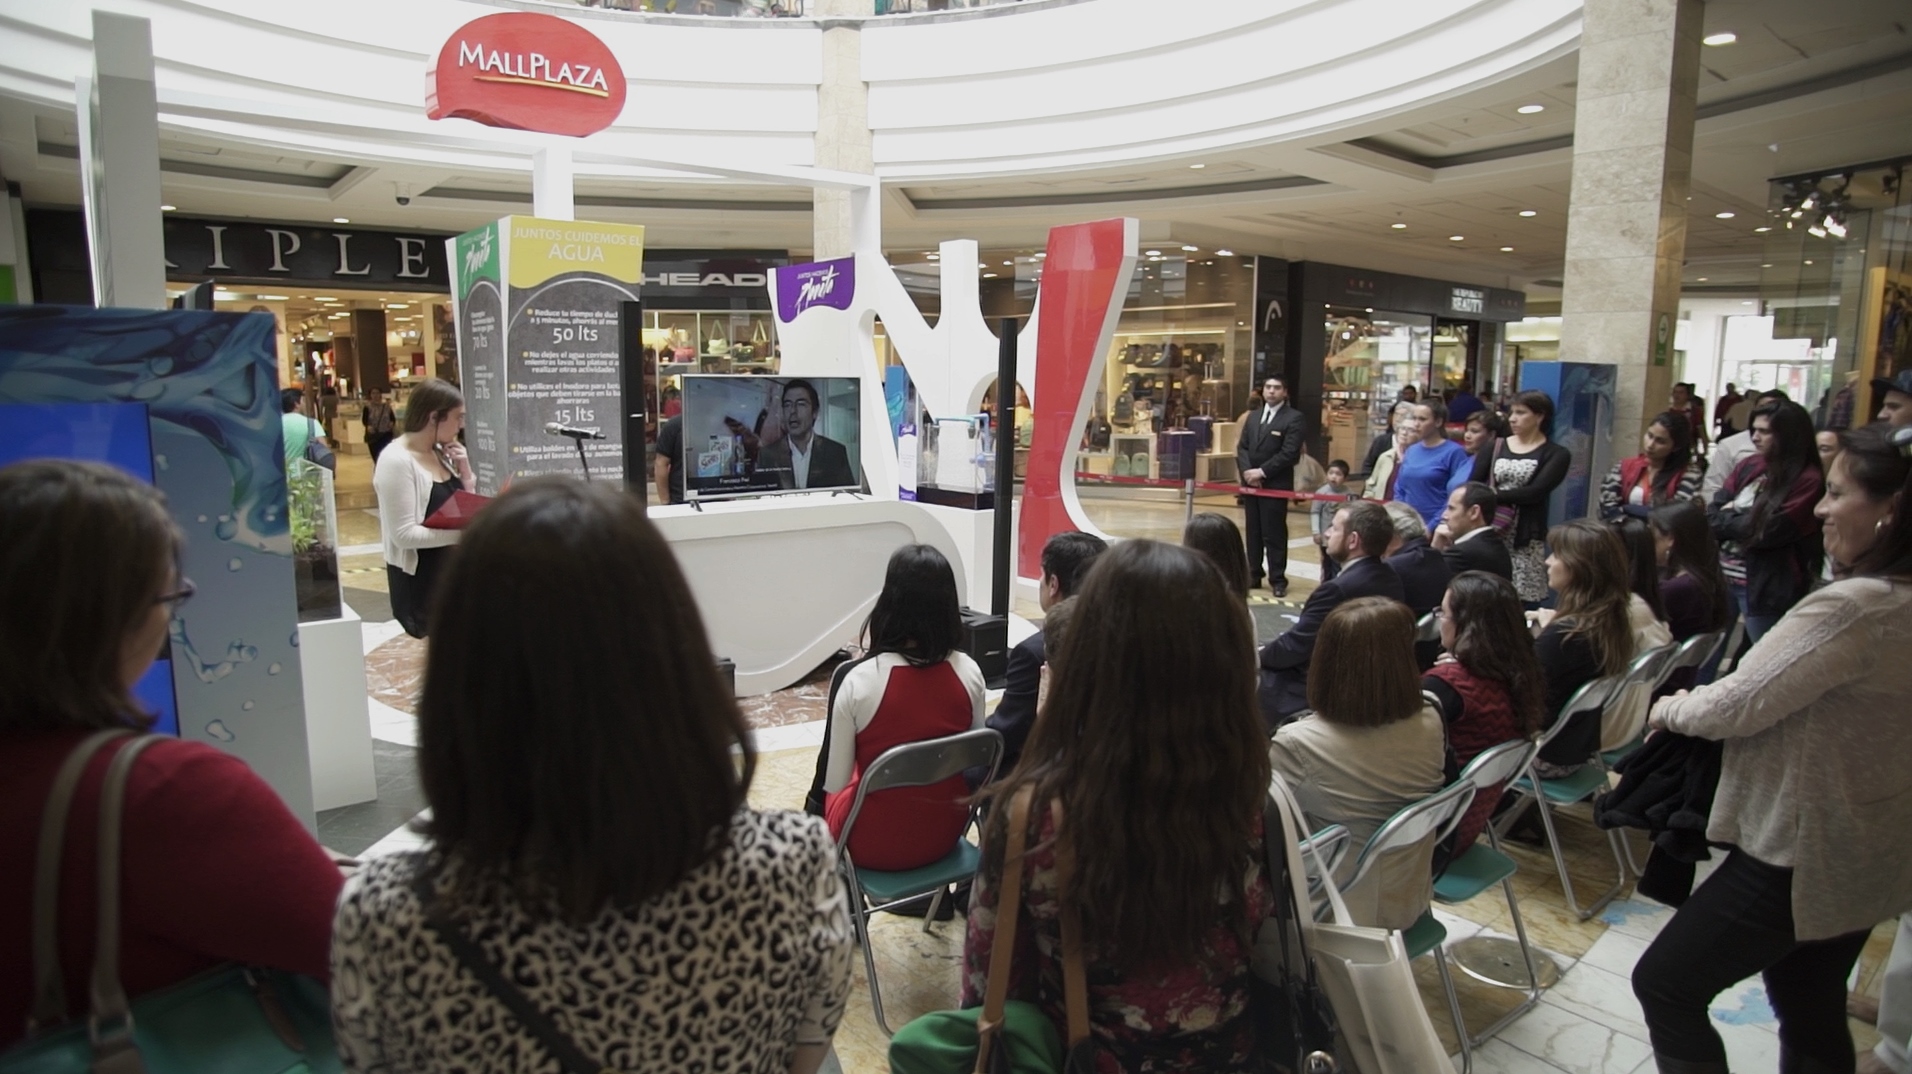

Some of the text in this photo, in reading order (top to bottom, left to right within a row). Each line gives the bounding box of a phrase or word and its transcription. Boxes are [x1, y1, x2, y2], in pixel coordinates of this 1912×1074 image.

[514, 228, 642, 246] JUNTOS CUIDEMOS EL
[165, 226, 430, 278] IPLE
[548, 243, 605, 263] AGUA
[640, 272, 767, 286] HEAD
[570, 310, 594, 319] tiempo
[553, 325, 598, 344] 50 lts
[541, 351, 559, 360] dejes
[587, 359, 607, 367] platos
[532, 366, 558, 374] realizar
[529, 382, 554, 390] utilices
[590, 383, 606, 391] para
[508, 391, 534, 399] objetos
[535, 391, 549, 399] que
[555, 406, 595, 425] 15 lts
[527, 453, 542, 461] para
[543, 452, 551, 460] el
